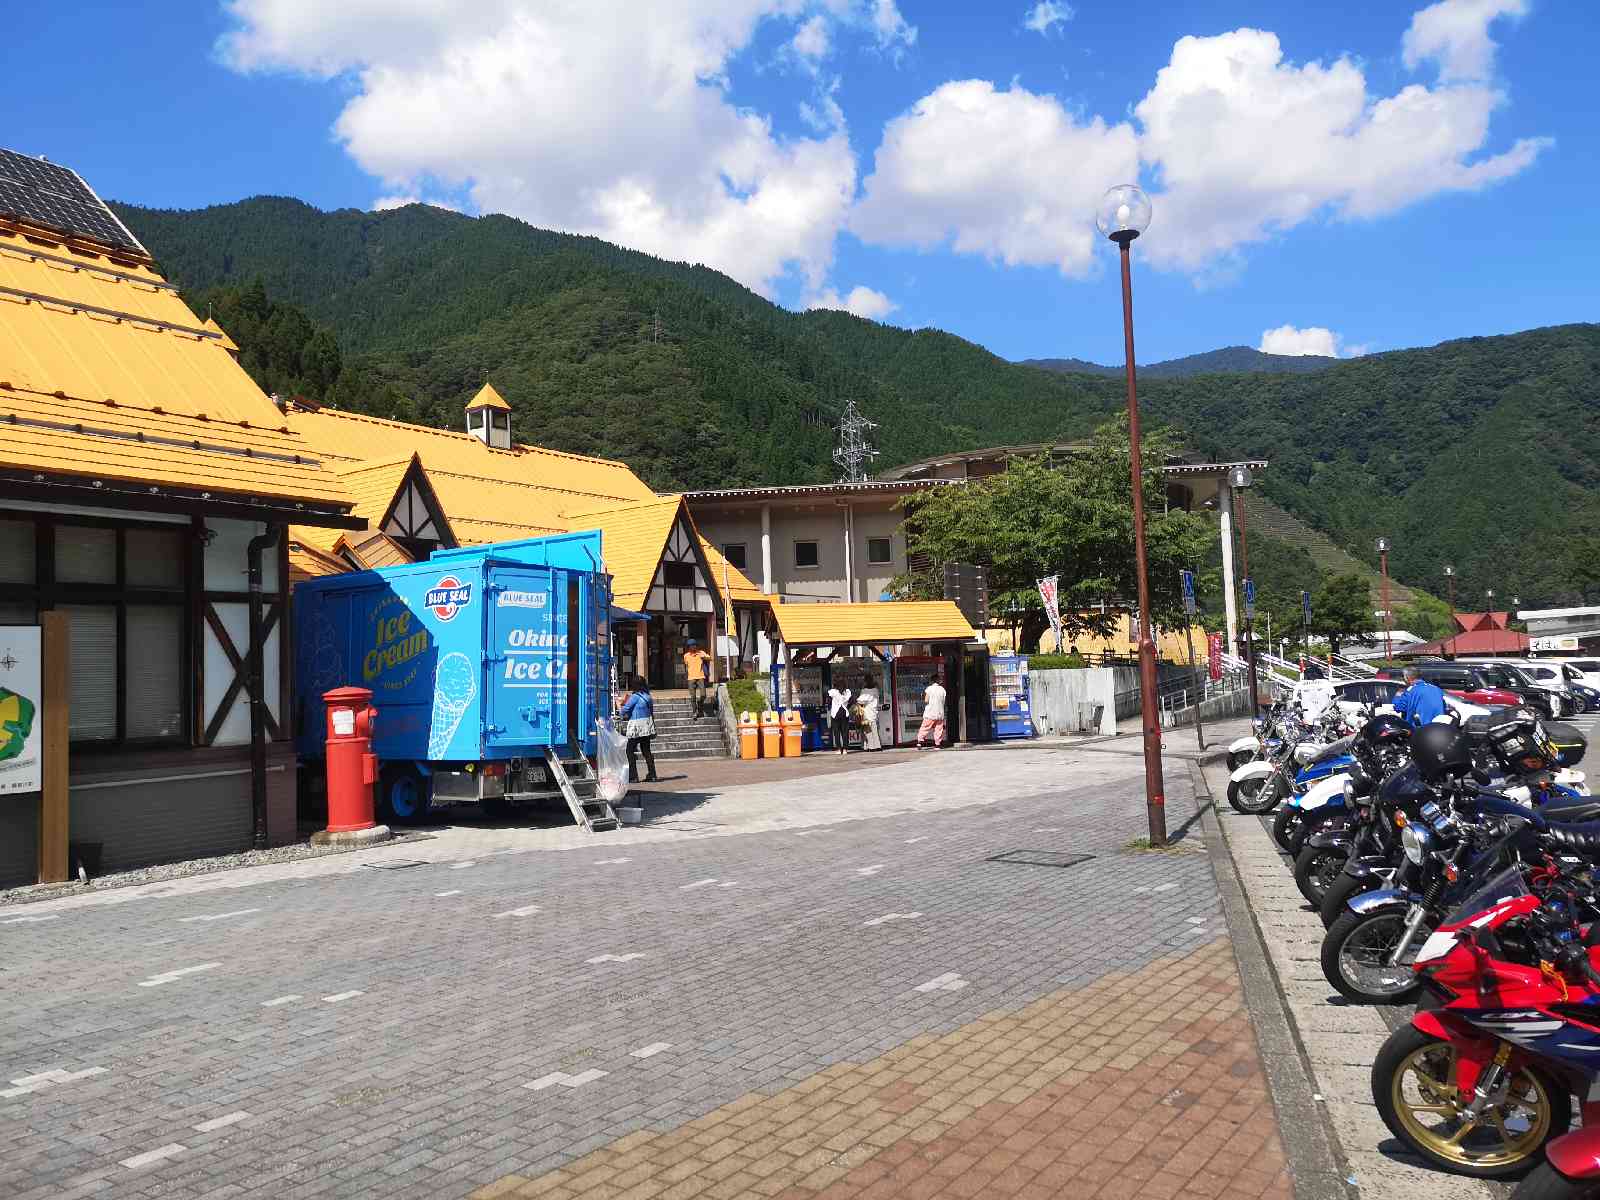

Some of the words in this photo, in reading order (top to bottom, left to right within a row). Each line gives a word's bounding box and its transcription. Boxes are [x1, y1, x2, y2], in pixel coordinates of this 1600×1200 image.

[428, 591, 448, 605] BLUE
[449, 589, 469, 602] SEAL
[526, 593, 545, 603] SEAL
[375, 610, 411, 646] Ice
[363, 629, 429, 681] Cream
[504, 658, 541, 680] Ice
